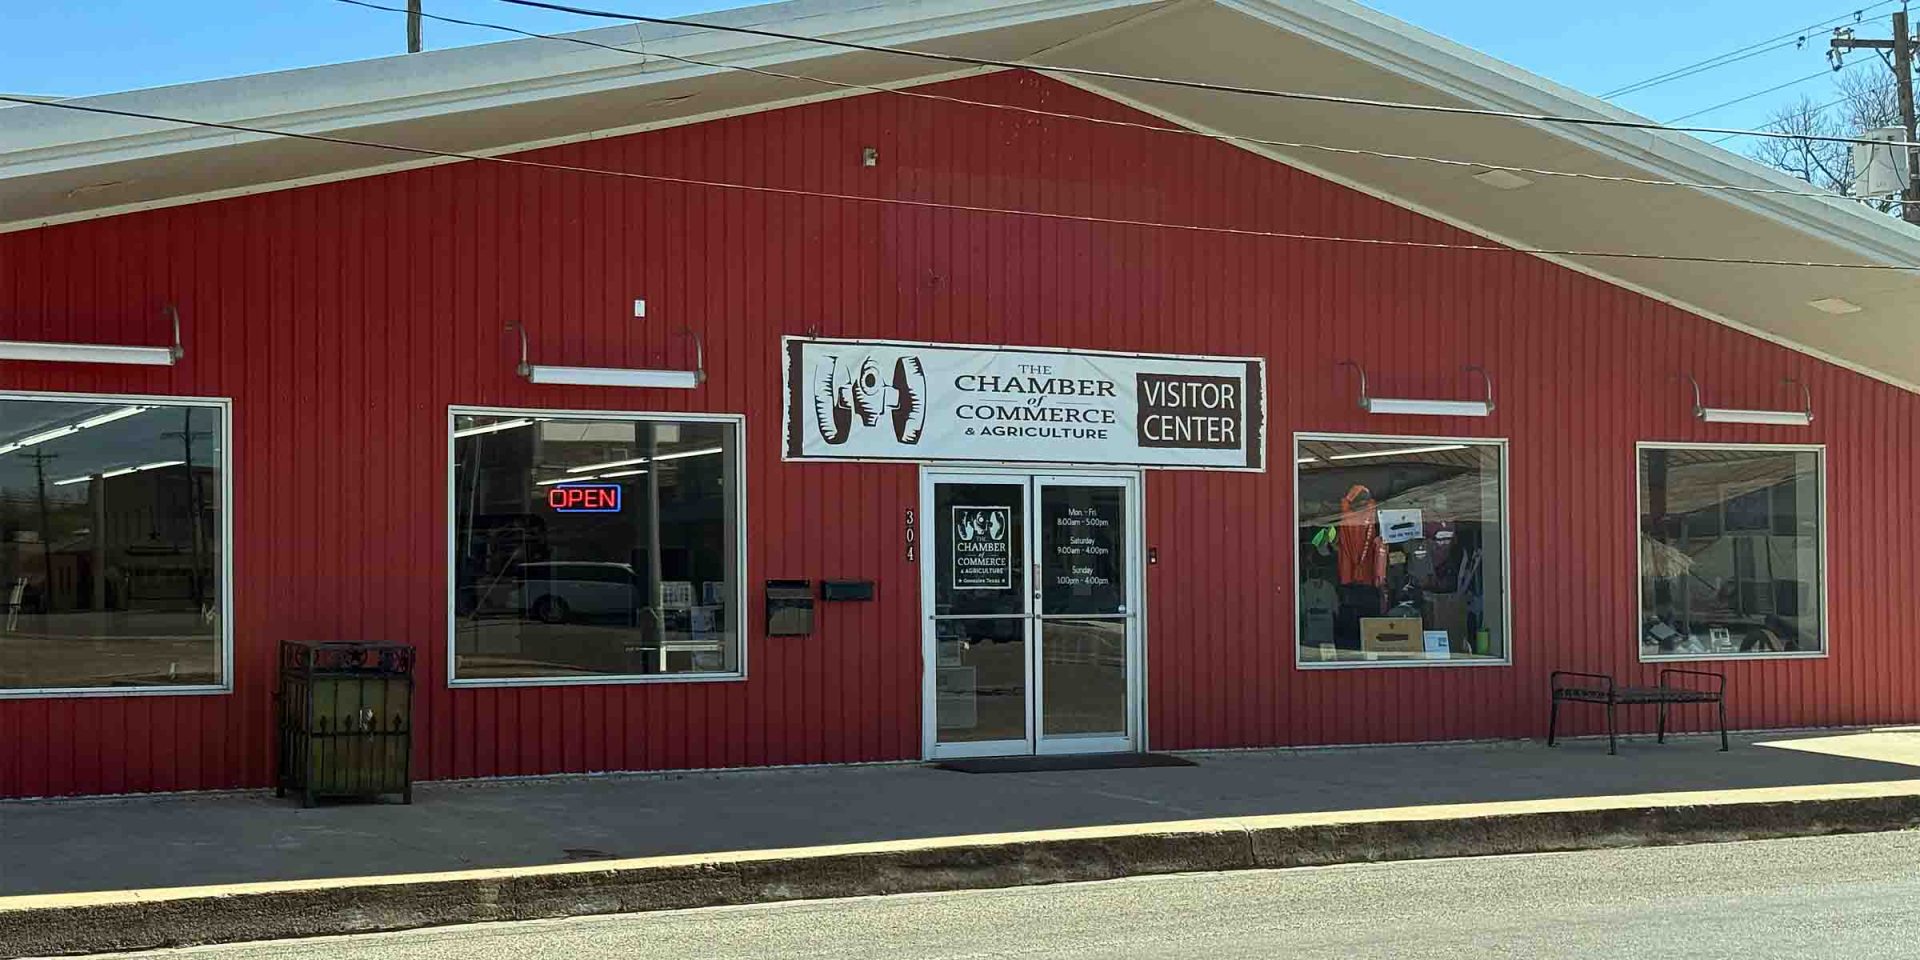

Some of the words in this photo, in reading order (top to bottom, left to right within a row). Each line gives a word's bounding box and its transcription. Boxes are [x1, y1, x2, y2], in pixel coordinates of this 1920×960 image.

[1018, 364, 1052, 375] THE
[954, 375, 1117, 397] CHAMBER
[1027, 395, 1047, 407] of
[1143, 380, 1235, 409] VISITOR
[955, 404, 1116, 424] COMMERCE
[964, 427, 975, 436] &
[980, 426, 1108, 440] AGRICULTURE
[1143, 414, 1235, 442] CENTER
[550, 489, 615, 507] OPEN
[906, 510, 914, 561] 304
[1070, 536, 1095, 545] Saturday
[957, 542, 1006, 552] CHAMBER
[957, 557, 1006, 566] COMMERCE
[1072, 565, 1094, 575] Sunday
